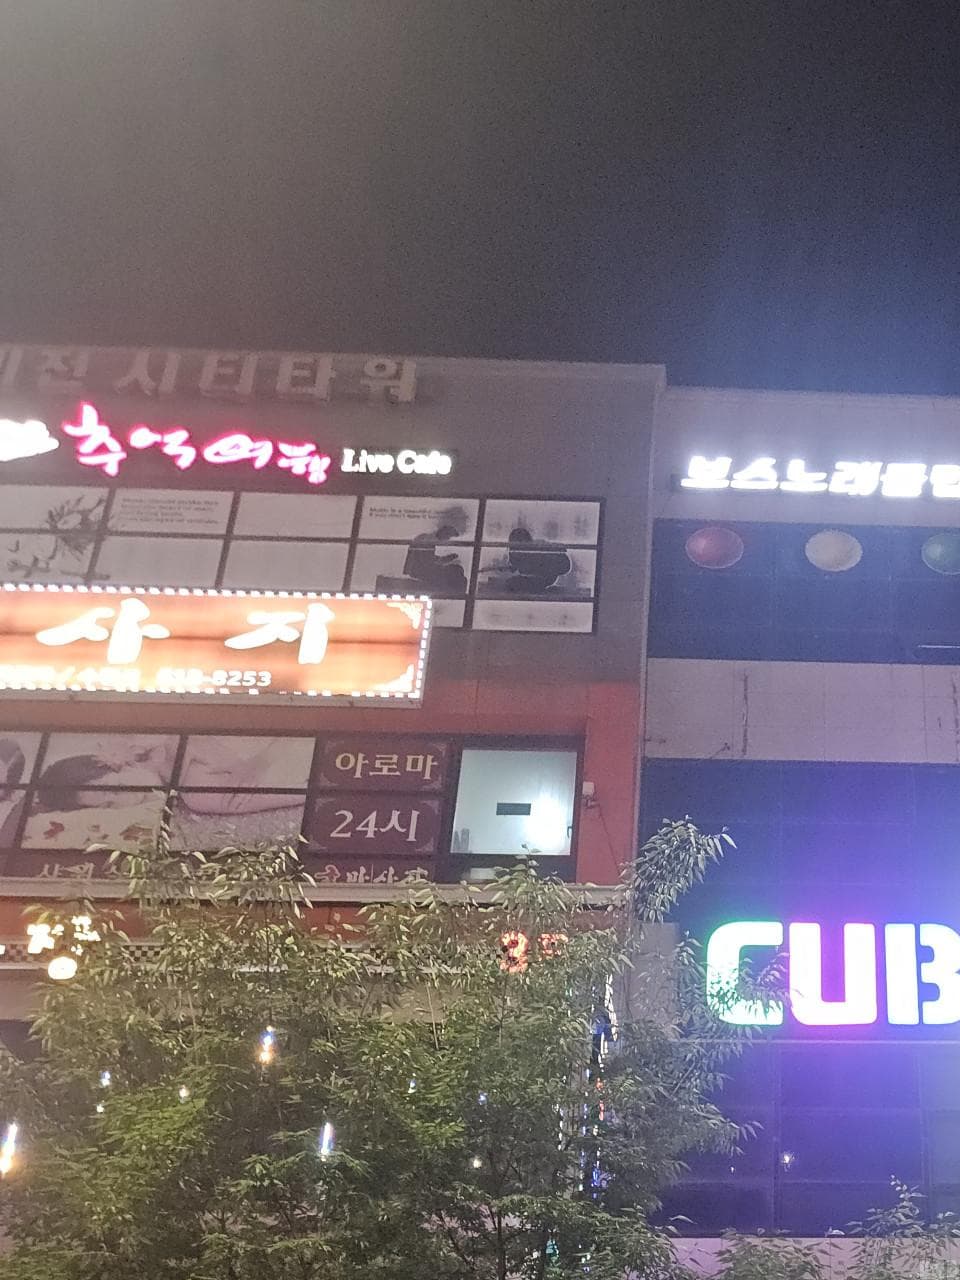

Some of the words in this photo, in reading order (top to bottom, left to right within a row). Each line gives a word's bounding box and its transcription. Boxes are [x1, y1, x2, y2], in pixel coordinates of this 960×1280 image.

[0, 346, 417, 404] 전시티타워
[342, 448, 394, 474] Live
[397, 449, 452, 475] Cafe
[335, 751, 438, 780] 아로마
[330, 809, 420, 842] 24시
